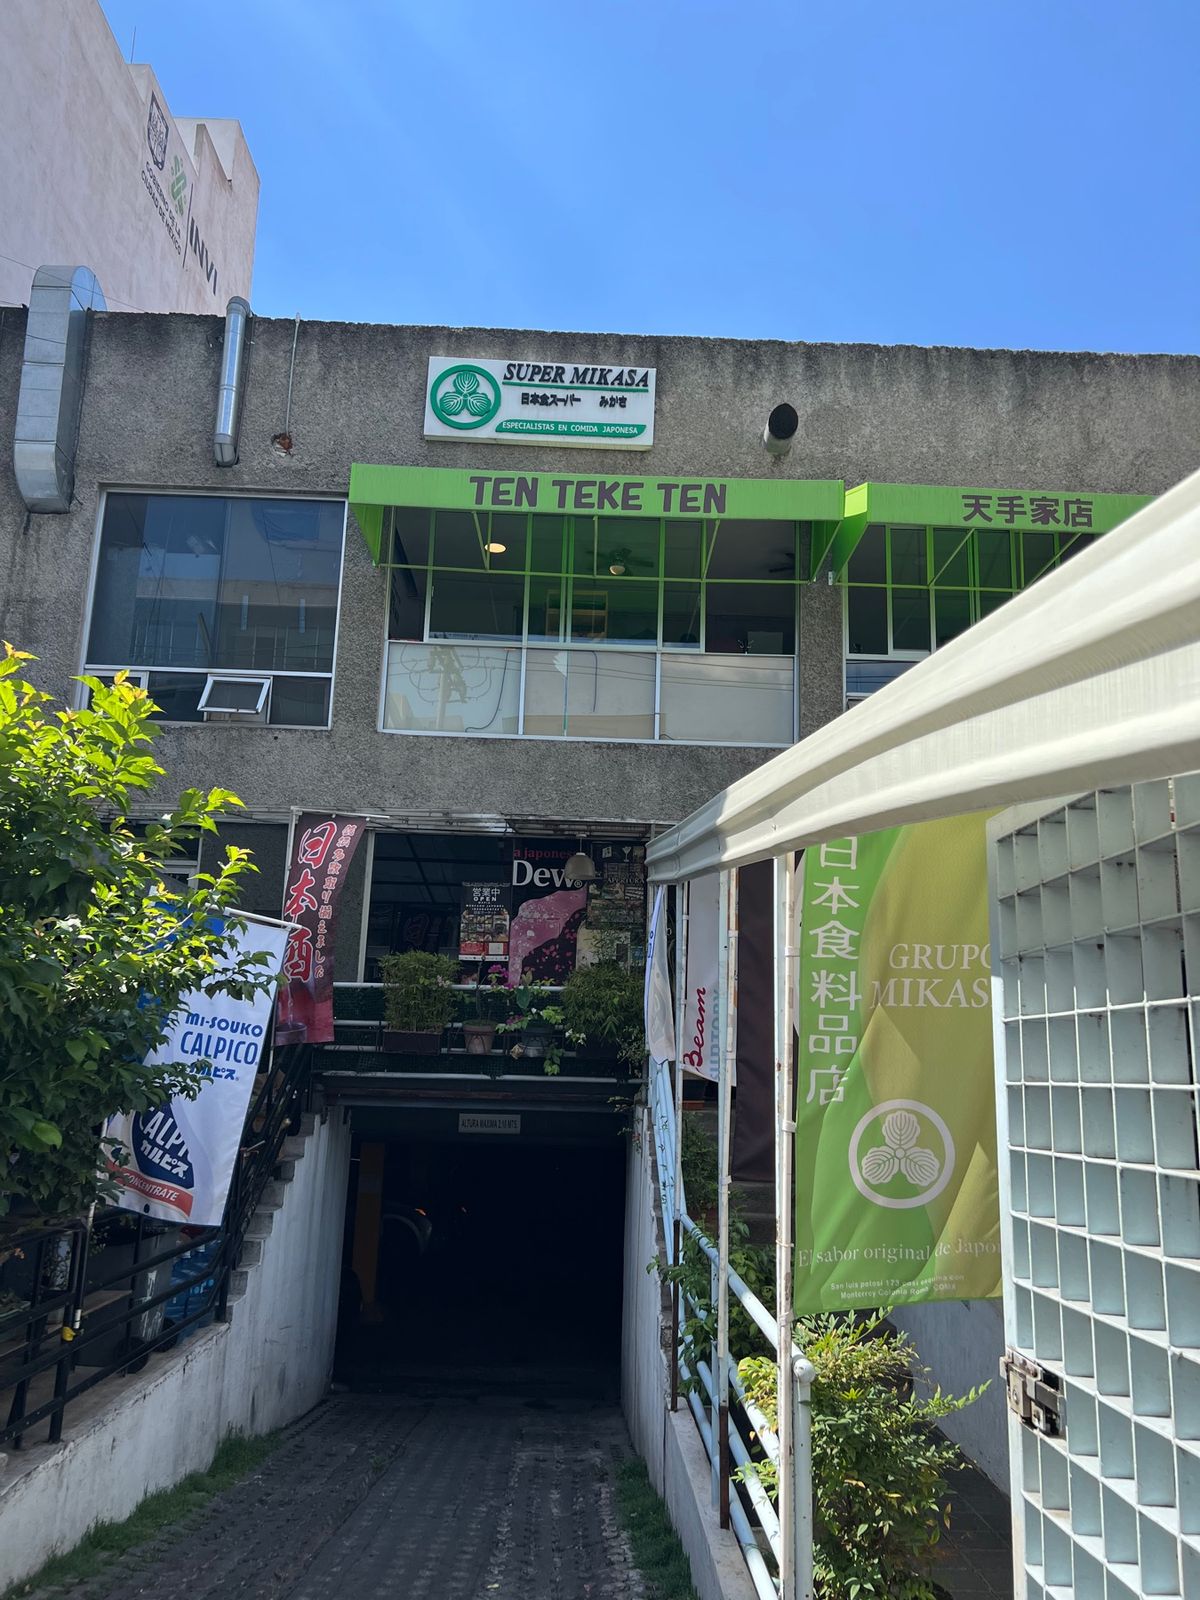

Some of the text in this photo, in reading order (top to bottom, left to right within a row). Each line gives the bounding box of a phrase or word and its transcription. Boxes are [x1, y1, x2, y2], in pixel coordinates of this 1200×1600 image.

[189, 216, 218, 296] INVI
[504, 363, 649, 387] SUPER MIKASA
[599, 396, 628, 408] みかさ
[502, 421, 638, 434] ESPECIALISTAS EN COMIDA JAPONESA
[469, 476, 727, 514] TEN TEKE TEN
[961, 494, 1094, 528] 天手家店
[869, 977, 993, 1009] MIKAS
[185, 1013, 264, 1038] MI-SOUKO
[683, 987, 706, 1068] Beam
[180, 1031, 259, 1065] CALPICO
[799, 1249, 813, 1267] El
[816, 1246, 859, 1264] sabor
[863, 1243, 930, 1263] original
[934, 1241, 951, 1257] de
